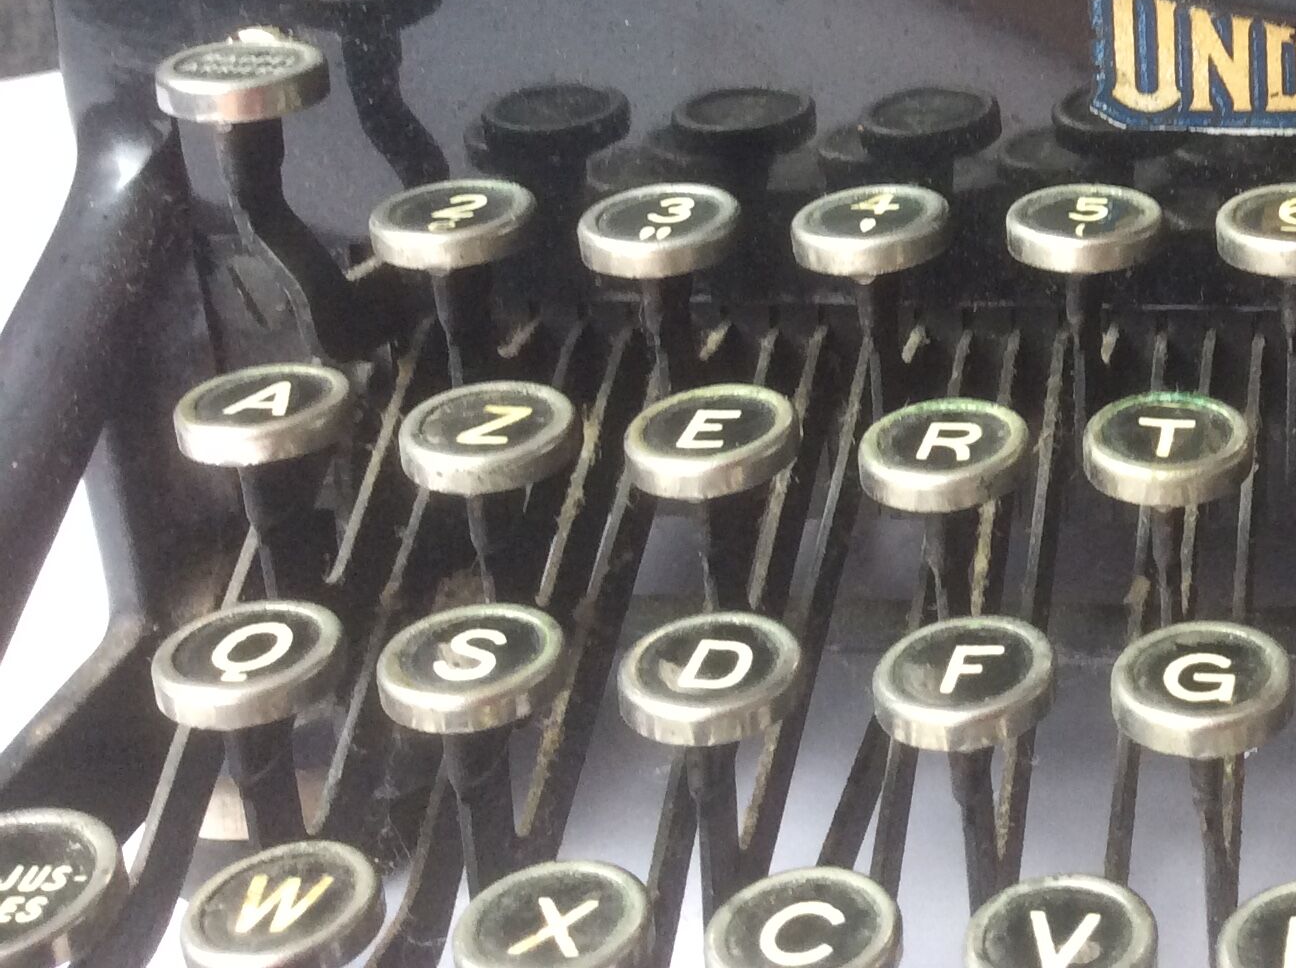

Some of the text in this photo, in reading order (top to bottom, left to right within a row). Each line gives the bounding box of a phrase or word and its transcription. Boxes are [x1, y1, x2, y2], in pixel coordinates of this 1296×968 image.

[431, 194, 487, 219] 2
[648, 197, 694, 223] 3
[850, 193, 899, 215] 4
[1069, 196, 1108, 221] 5
[223, 381, 291, 416] A
[456, 405, 532, 444] Z
[676, 409, 741, 449] E
[916, 422, 982, 461] R
[1139, 417, 1196, 457] T
[211, 622, 293, 682] Q
[433, 629, 507, 682] S
[676, 639, 753, 690] D
[940, 645, 1004, 694] F
[1163, 653, 1235, 703] G
[234, 874, 334, 933] W
[507, 897, 599, 958] X
[759, 901, 845, 967] C
[1029, 910, 1101, 968] V
